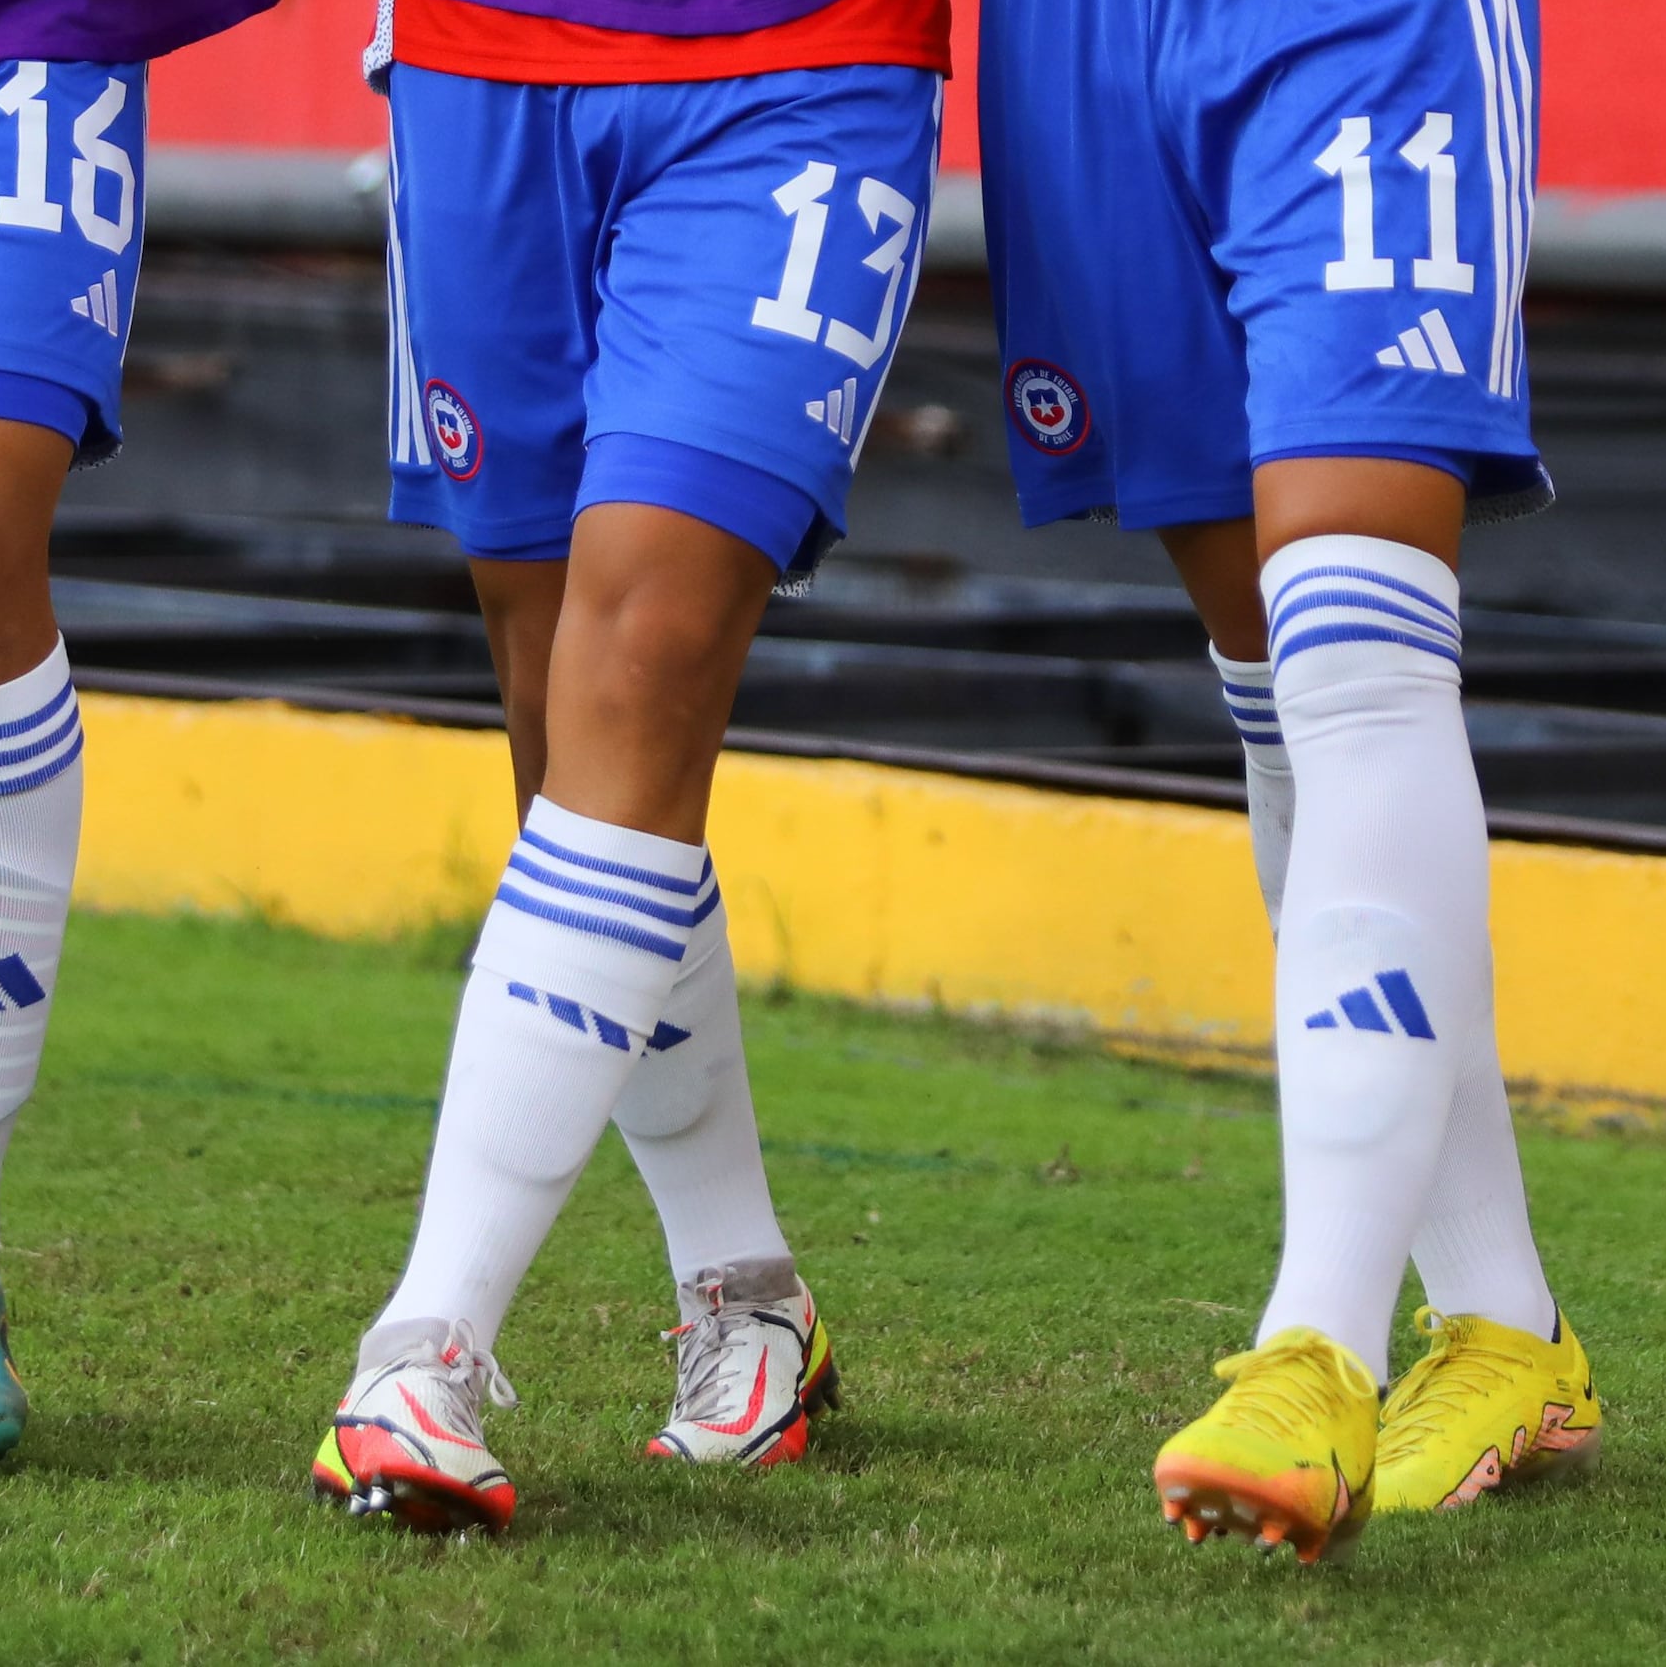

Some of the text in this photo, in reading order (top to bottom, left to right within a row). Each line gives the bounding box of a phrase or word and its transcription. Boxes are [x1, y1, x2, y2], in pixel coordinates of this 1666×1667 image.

[1314, 112, 1474, 293] 11
[751, 160, 915, 370] 13
[1039, 369, 1050, 379] DE
[1053, 375, 1079, 403] FUTBOL
[1052, 429, 1073, 445] CHILE
